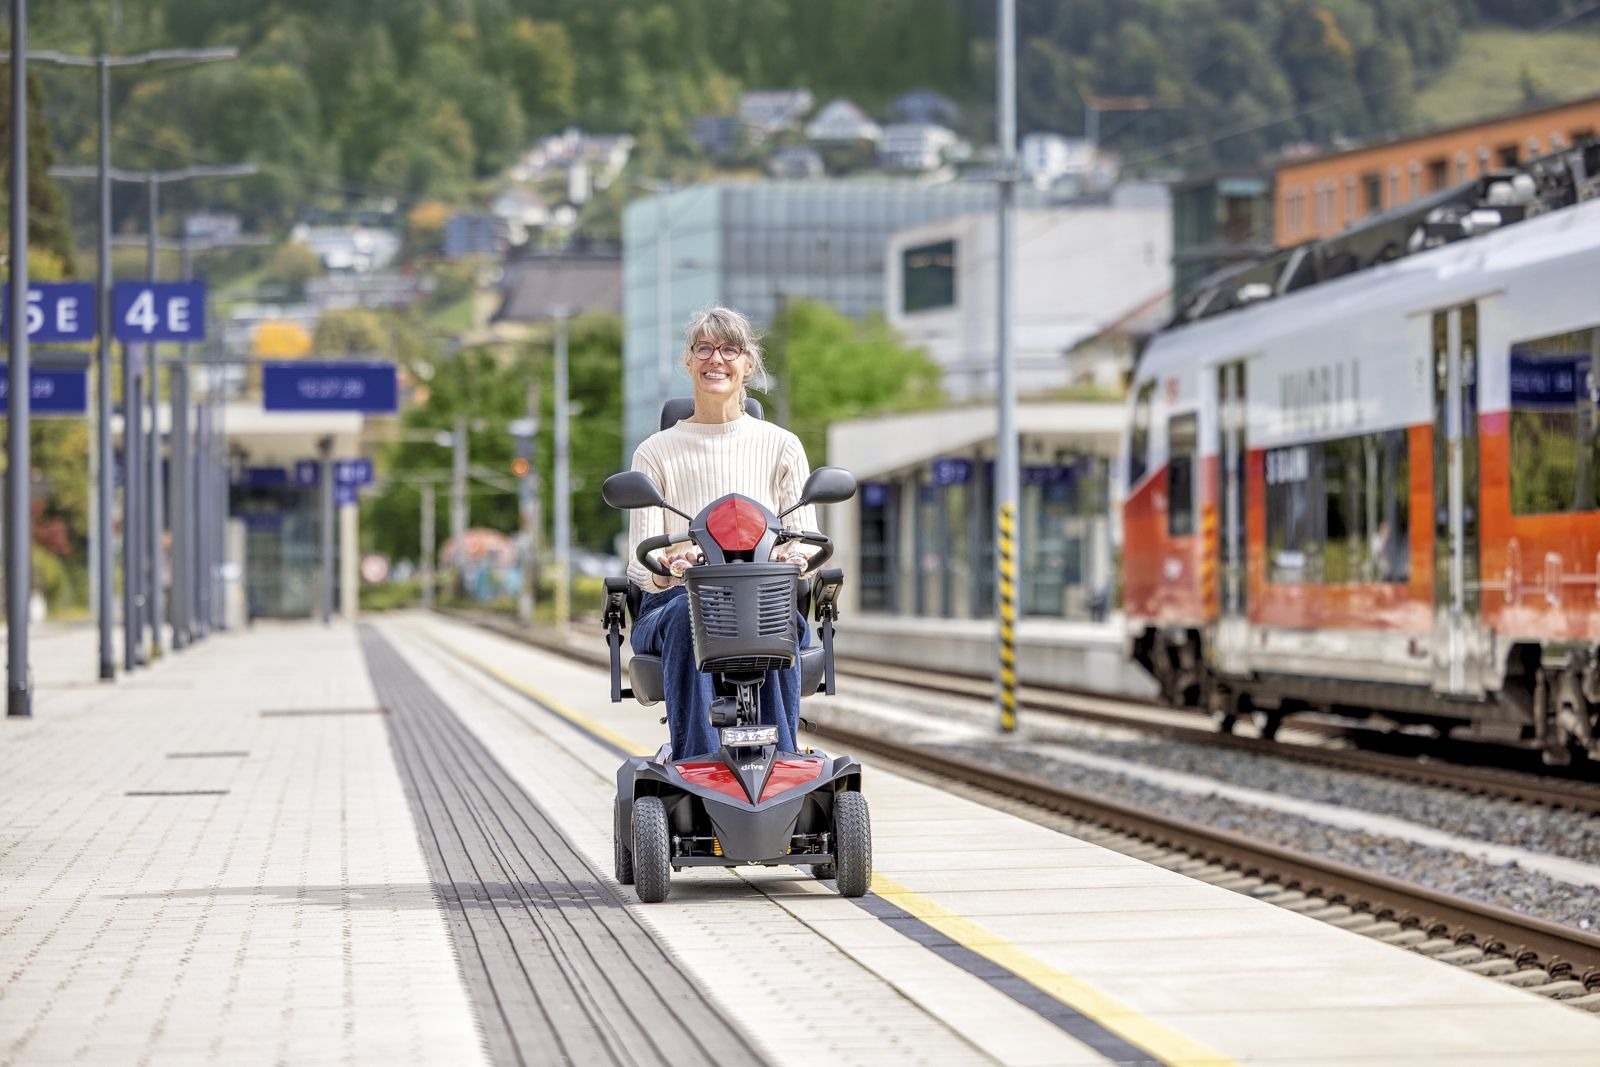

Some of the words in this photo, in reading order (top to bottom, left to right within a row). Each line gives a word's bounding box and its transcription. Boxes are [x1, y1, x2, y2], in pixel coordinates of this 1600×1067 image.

[56, 297, 79, 333] E
[124, 288, 160, 334] 4
[167, 297, 191, 333] E
[741, 762, 764, 771] drive
